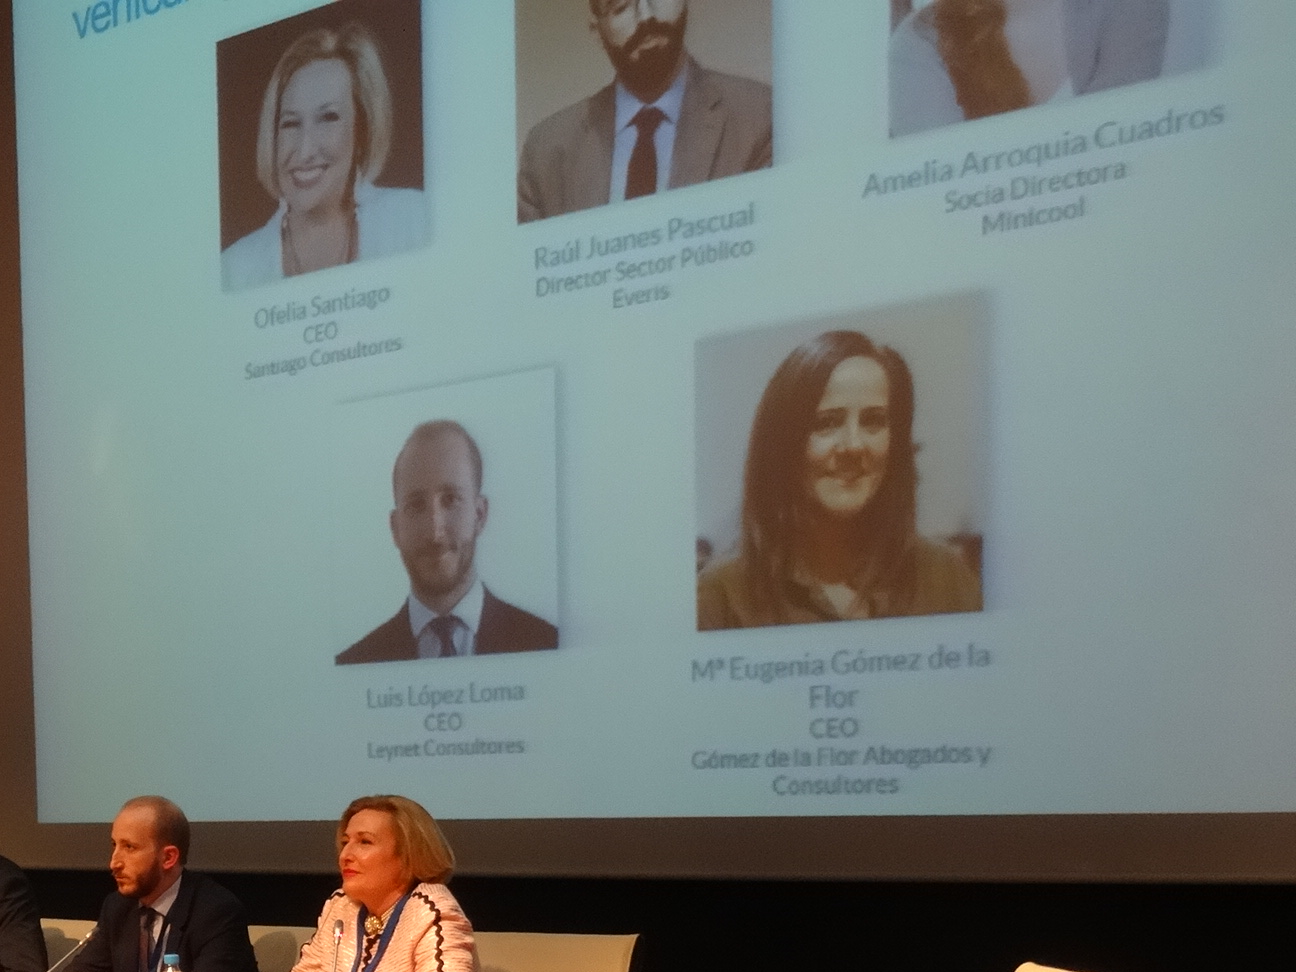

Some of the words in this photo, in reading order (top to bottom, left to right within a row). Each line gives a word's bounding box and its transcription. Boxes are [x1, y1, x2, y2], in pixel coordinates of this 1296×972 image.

[862, 158, 953, 198] Amelia
[959, 131, 1088, 176] Arroquia
[1095, 103, 1226, 150] Cuadros
[944, 185, 1005, 214] Socia
[1009, 161, 1127, 200] Directora
[982, 198, 1086, 236] Minicool
[534, 240, 581, 269] Raúl
[586, 228, 661, 260] Juanes
[667, 203, 755, 241] Pascual
[535, 268, 610, 297] Director
[615, 254, 674, 282] Sector
[680, 239, 754, 268] Público
[254, 302, 306, 328] Ofelia
[311, 288, 391, 318] Santiago
[612, 285, 671, 309] Everis
[303, 321, 339, 344] CEO
[244, 355, 307, 381] Santiago
[310, 337, 403, 367] Consultores
[730, 652, 825, 683] Eugenia
[831, 649, 922, 675] Gómez
[929, 645, 963, 669] de
[967, 643, 991, 668] la
[366, 687, 404, 709] Luis
[407, 684, 465, 710] López
[469, 682, 525, 703] Loma
[809, 684, 859, 710] Flor
[423, 712, 462, 732] CEO
[809, 717, 859, 740] CEO
[367, 742, 420, 761] Leynet
[423, 738, 525, 757] Consultores
[691, 750, 760, 771] Gómez
[763, 749, 787, 768] de
[792, 748, 811, 767] la
[816, 746, 857, 767] Flor
[862, 744, 971, 769] Abogados
[975, 745, 992, 768] y
[772, 774, 899, 797] Consultores
